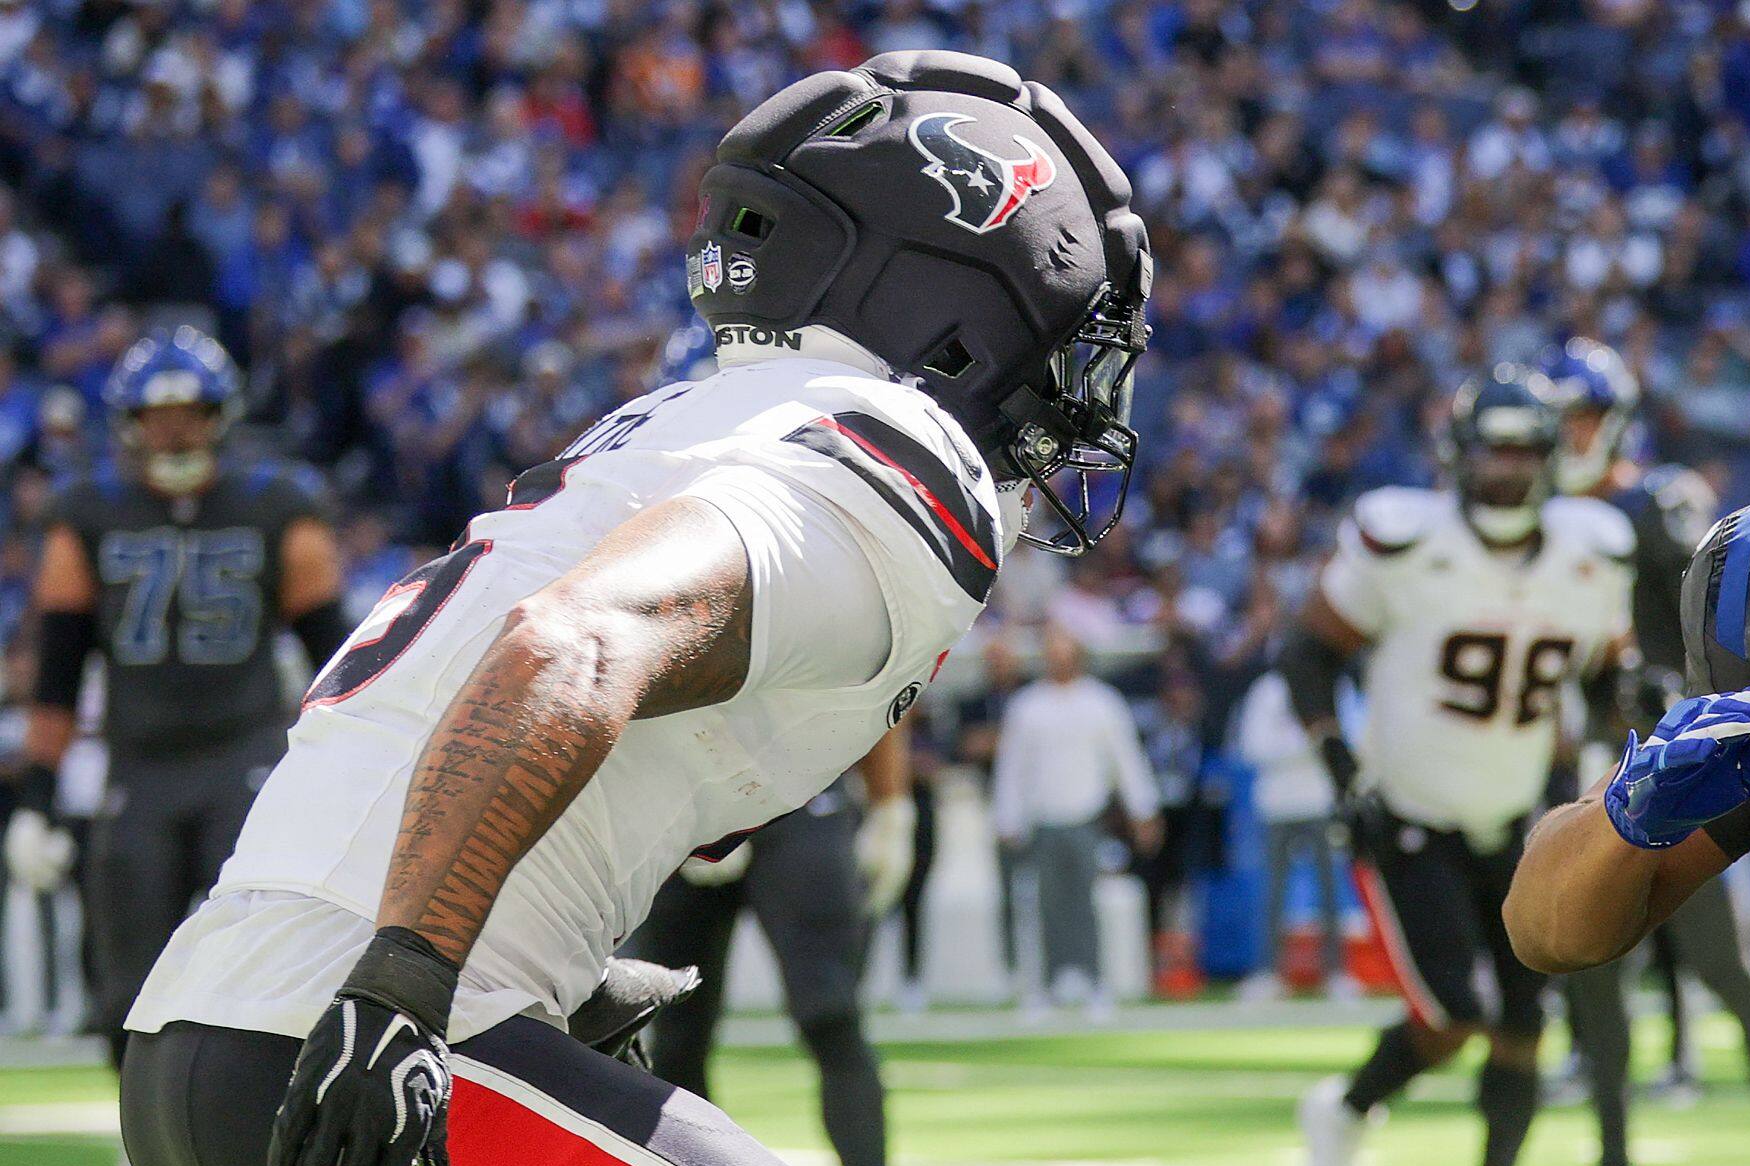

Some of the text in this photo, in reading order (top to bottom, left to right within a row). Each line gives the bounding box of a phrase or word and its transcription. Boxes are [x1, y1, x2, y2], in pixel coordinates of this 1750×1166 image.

[716, 326, 802, 350] STON
[99, 525, 266, 666] 75
[1440, 631, 1574, 727] 98
